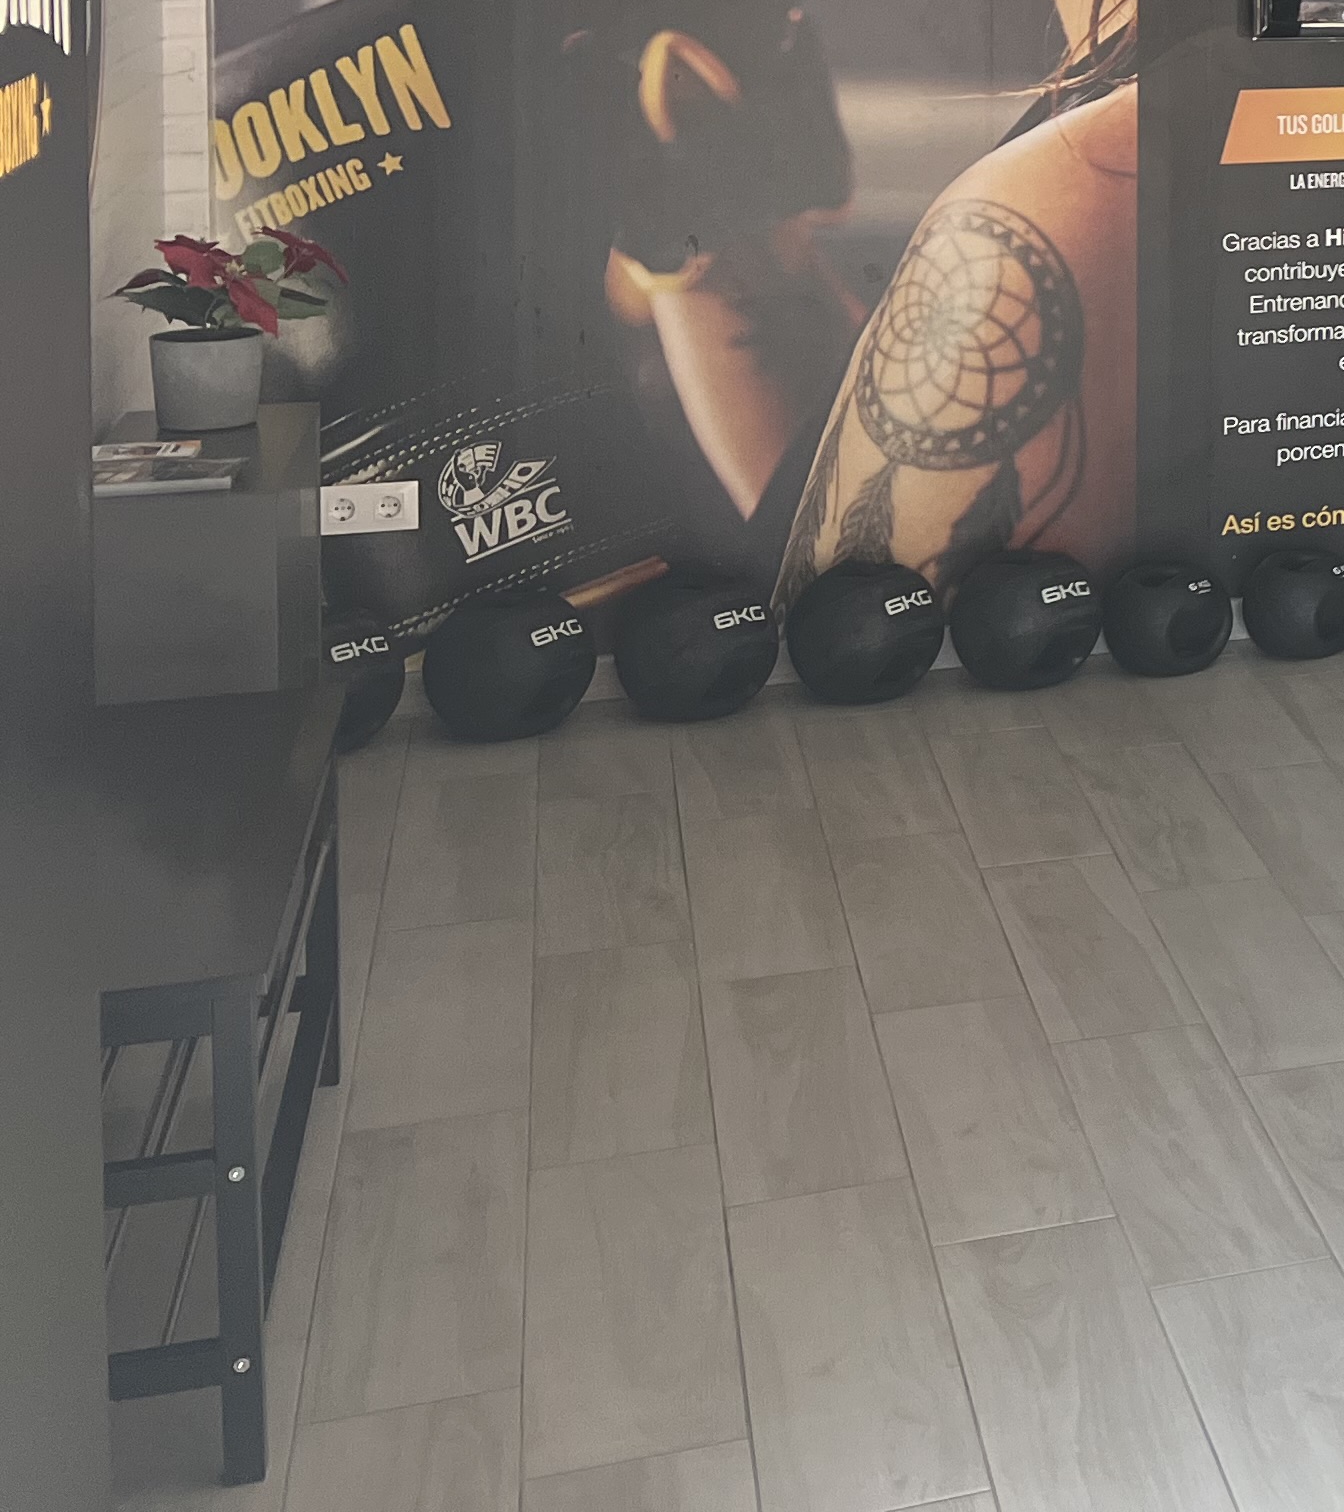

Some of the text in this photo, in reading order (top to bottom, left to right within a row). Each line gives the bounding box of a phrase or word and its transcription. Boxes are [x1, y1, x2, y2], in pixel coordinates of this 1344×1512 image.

[1277, 115, 1307, 134] TUS
[1290, 174, 1305, 189] LA
[1223, 232, 1300, 251] Gracias
[1306, 234, 1319, 247] a
[1224, 417, 1270, 435] Para
[454, 486, 567, 556] WBC
[1222, 512, 1260, 535] Así
[1267, 515, 1295, 530] es
[885, 590, 932, 615] 6KG
[1042, 582, 1090, 603] 6KG
[714, 606, 765, 629] 6KG
[531, 619, 582, 646] 6KG
[331, 637, 388, 662] 6KG
